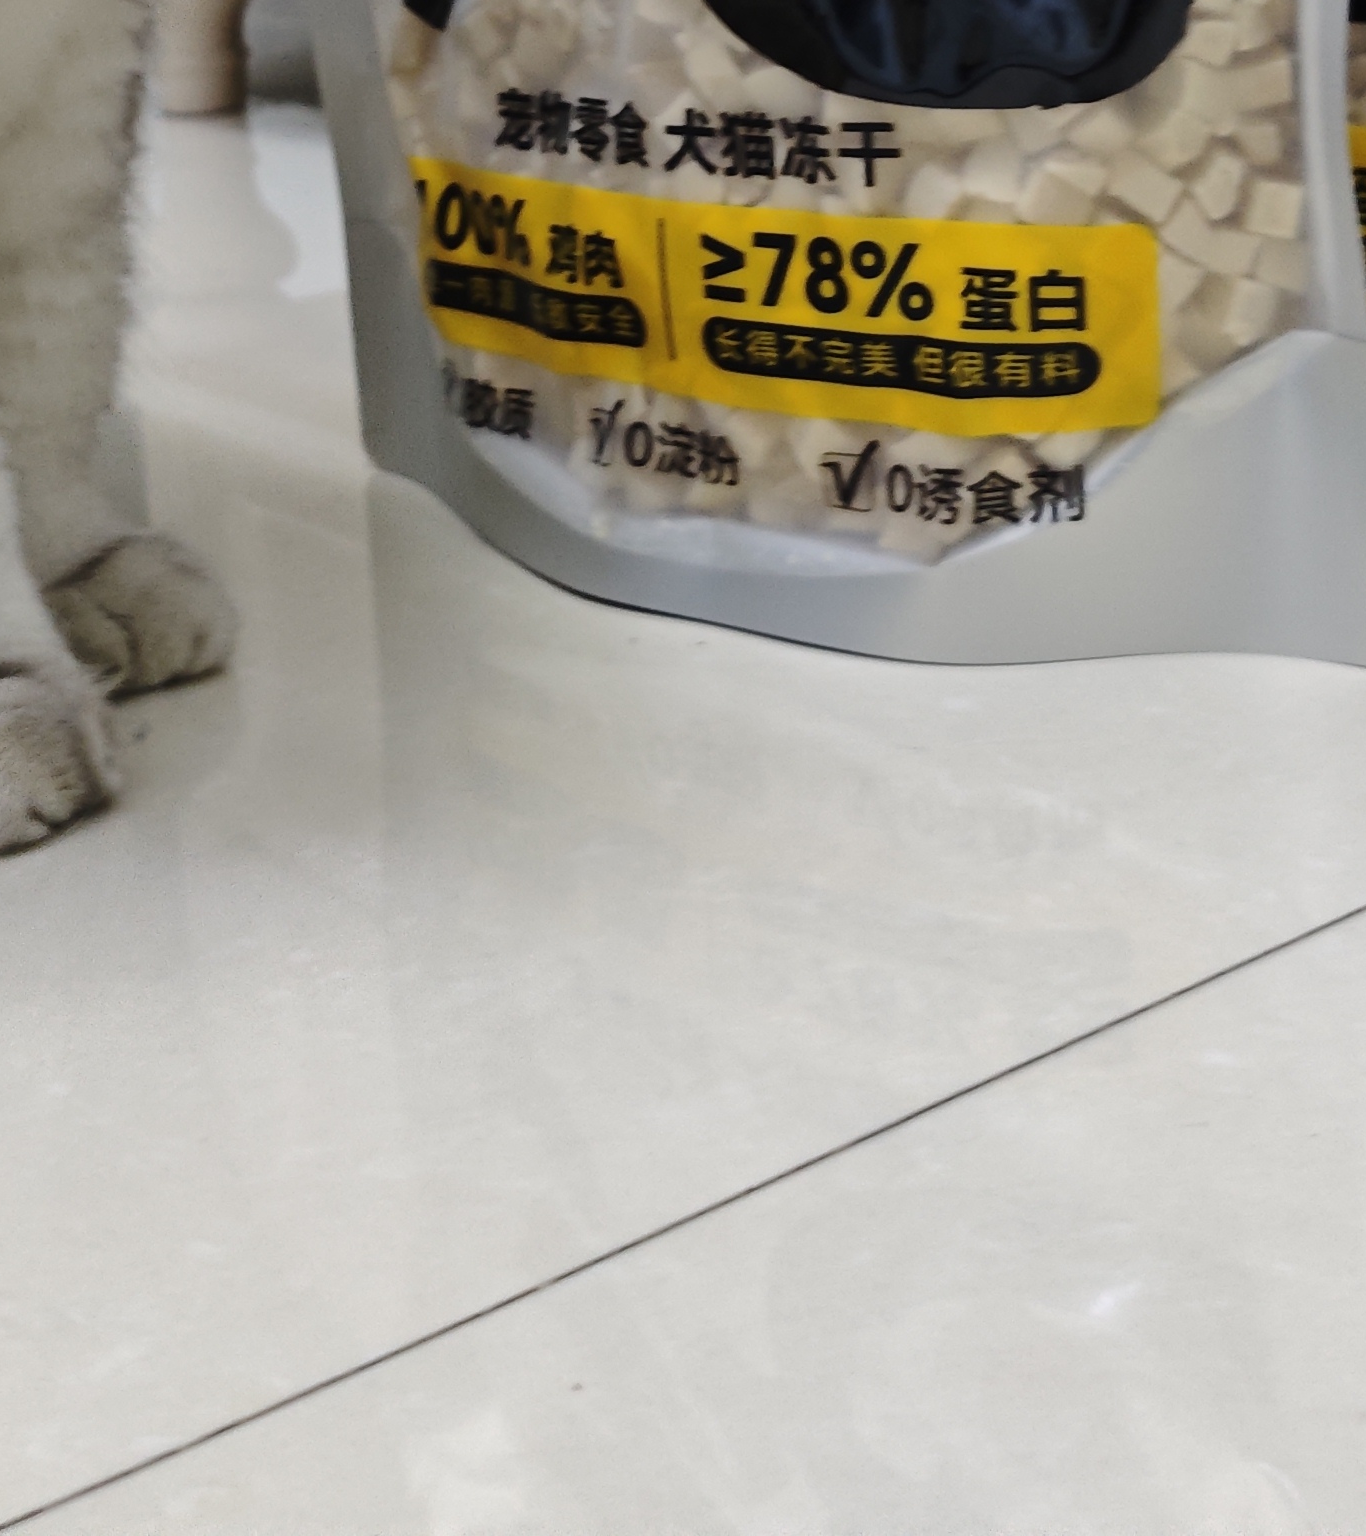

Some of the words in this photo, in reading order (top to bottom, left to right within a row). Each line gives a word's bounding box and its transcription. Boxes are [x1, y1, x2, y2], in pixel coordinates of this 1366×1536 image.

[495, 87, 651, 168] 宠物零食
[663, 108, 901, 188] 犬猫冻干
[959, 267, 1088, 333] 蛋白
[885, 463, 1087, 525] 0诱食剂
